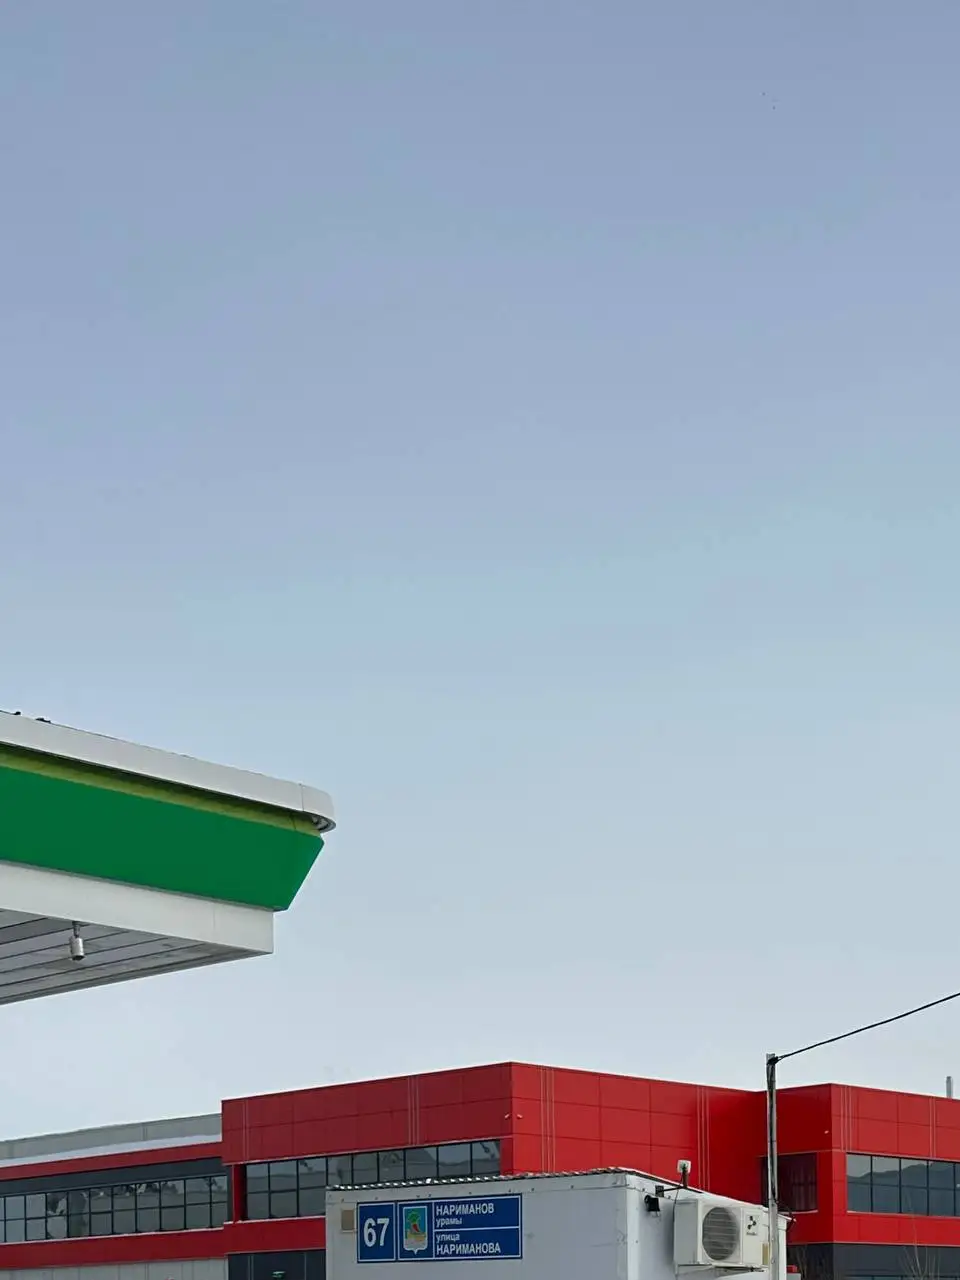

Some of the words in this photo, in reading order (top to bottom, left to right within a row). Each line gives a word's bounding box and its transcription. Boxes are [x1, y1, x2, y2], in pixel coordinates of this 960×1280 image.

[436, 1203, 495, 1216] НАРИМАНОВ
[436, 1217, 463, 1228] урамы
[363, 1217, 390, 1248] 67
[436, 1233, 460, 1243] улица
[436, 1242, 501, 1255] НАРИМАНОВА
